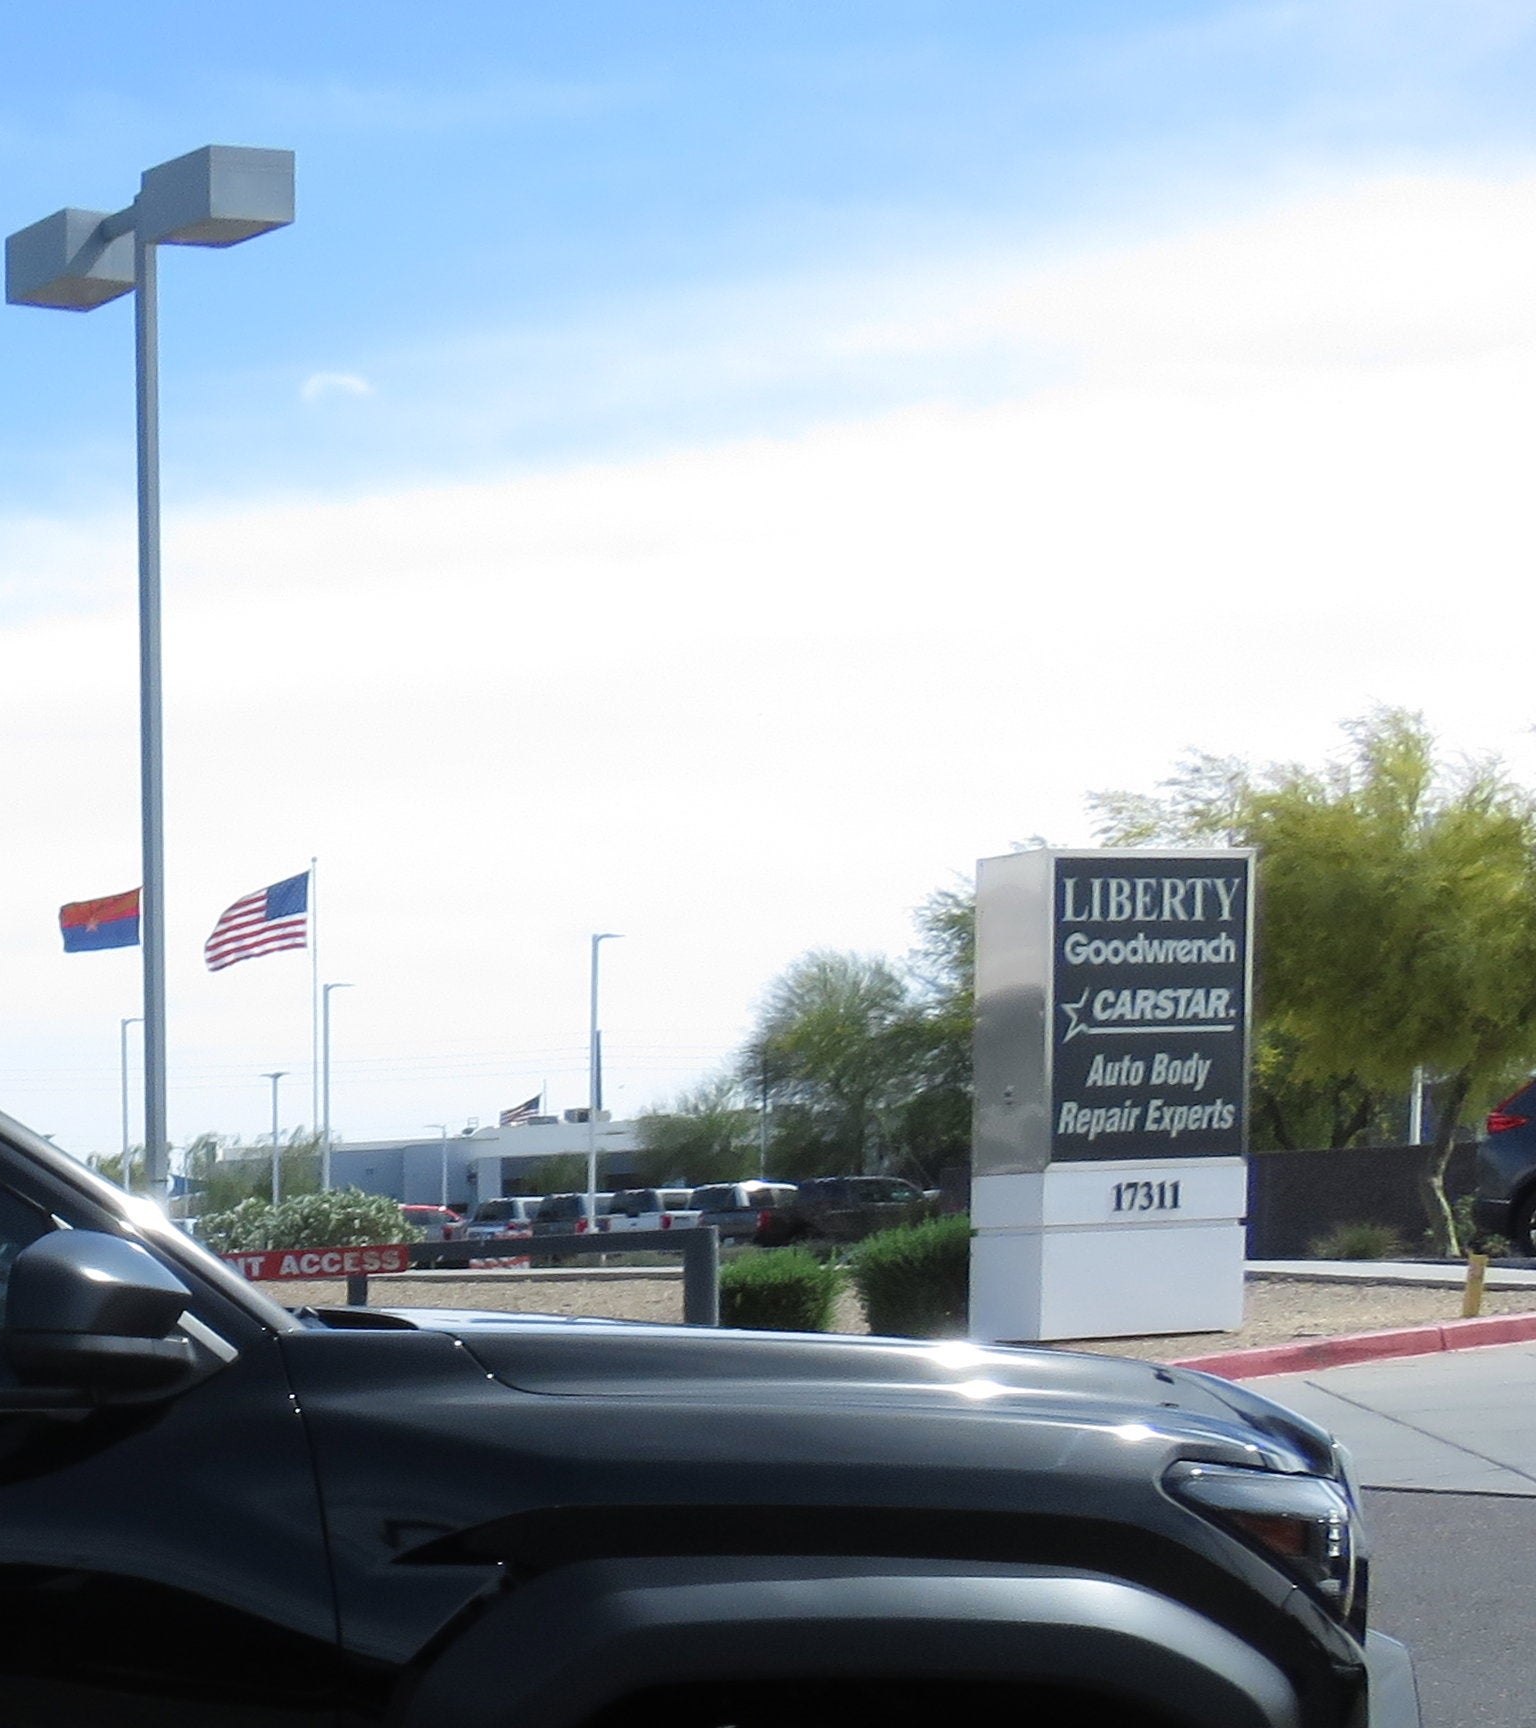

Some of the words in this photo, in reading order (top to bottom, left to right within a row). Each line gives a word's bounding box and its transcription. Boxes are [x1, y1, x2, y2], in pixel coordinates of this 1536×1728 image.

[1062, 877, 1241, 922] LIBERTY
[1064, 931, 1236, 965] Goodwrench
[1092, 987, 1235, 1021] CARSTAR
[1085, 1054, 1145, 1087] Auto
[1149, 1052, 1212, 1092] Body
[1058, 1101, 1141, 1141] Repair
[1144, 1097, 1235, 1138] Experts
[1112, 1180, 1181, 1212] 17311
[280, 1251, 401, 1275] ACCESS
